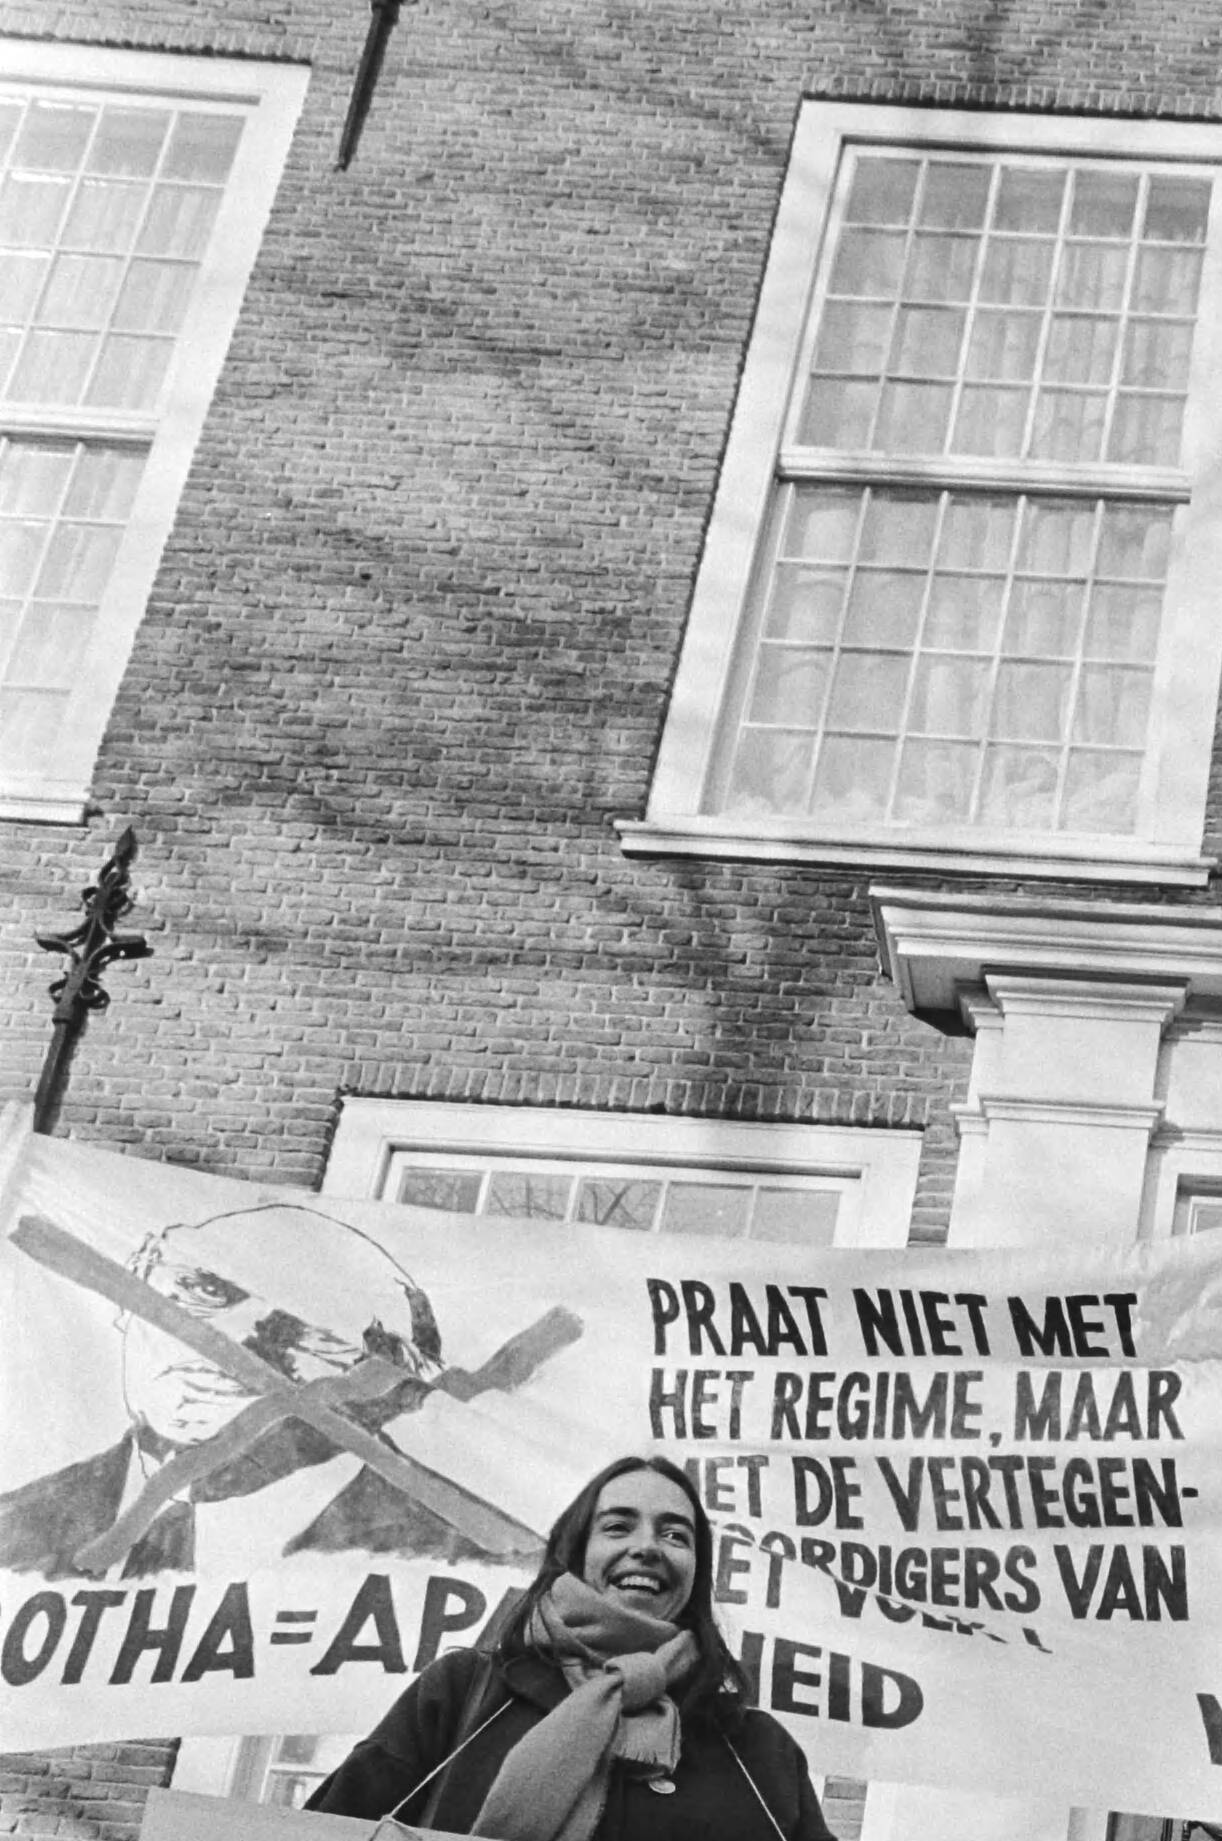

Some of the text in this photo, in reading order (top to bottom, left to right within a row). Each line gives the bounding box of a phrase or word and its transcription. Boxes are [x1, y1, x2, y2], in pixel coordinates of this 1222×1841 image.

[646, 1277, 1138, 1358] PRAAT NIET MET
[648, 1367, 1186, 1447] HET REGIME, MAAR
[684, 1454, 1199, 1533] ET DE VERTEGEN-
[713, 1534, 783, 1609] ET
[1053, 1543, 1190, 1622] VAN
[1, 1581, 255, 1687] OTHA
